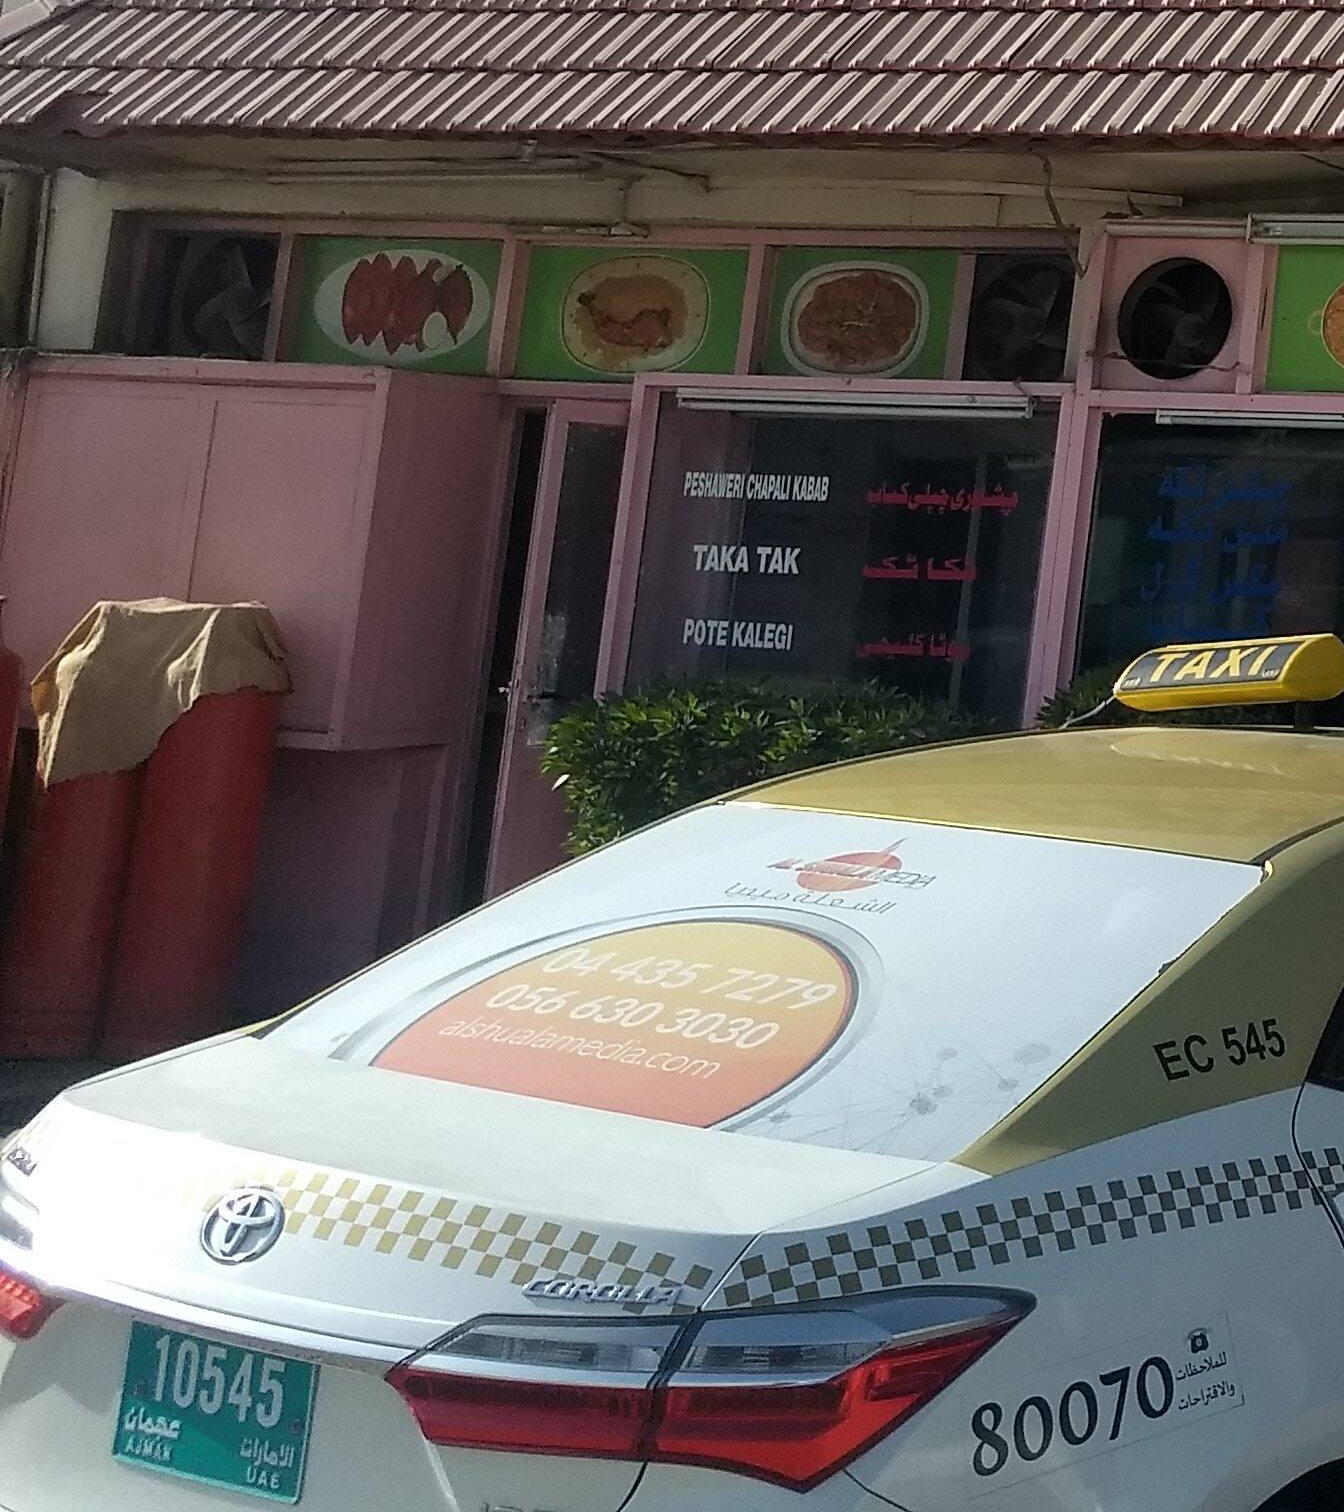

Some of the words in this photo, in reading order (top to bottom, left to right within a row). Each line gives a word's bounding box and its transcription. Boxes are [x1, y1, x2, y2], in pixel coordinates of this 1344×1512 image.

[684, 471, 744, 498] PESHAWERI
[746, 474, 791, 500] CHAPALI
[791, 475, 829, 501] KABAB
[694, 544, 749, 573] TAKA
[756, 546, 801, 575] TAK
[683, 618, 729, 646] POTE
[731, 621, 793, 650] KALEGI
[1150, 645, 1279, 683] TAXI
[542, 948, 617, 977] 04
[610, 956, 714, 989] 435
[701, 967, 838, 1010] 7279
[486, 984, 578, 1014] 056
[569, 995, 665, 1028] 630
[656, 1008, 781, 1050] 3030
[439, 1016, 722, 1081] alshualamedia.com
[1152, 1034, 1215, 1081] EC
[1221, 1018, 1286, 1066] 545
[521, 1280, 686, 1306] COROLLA
[153, 1334, 286, 1429] 10545
[971, 1355, 1175, 1477] 80070
[124, 1435, 173, 1462] AJMAN
[246, 1466, 281, 1490] UAE
